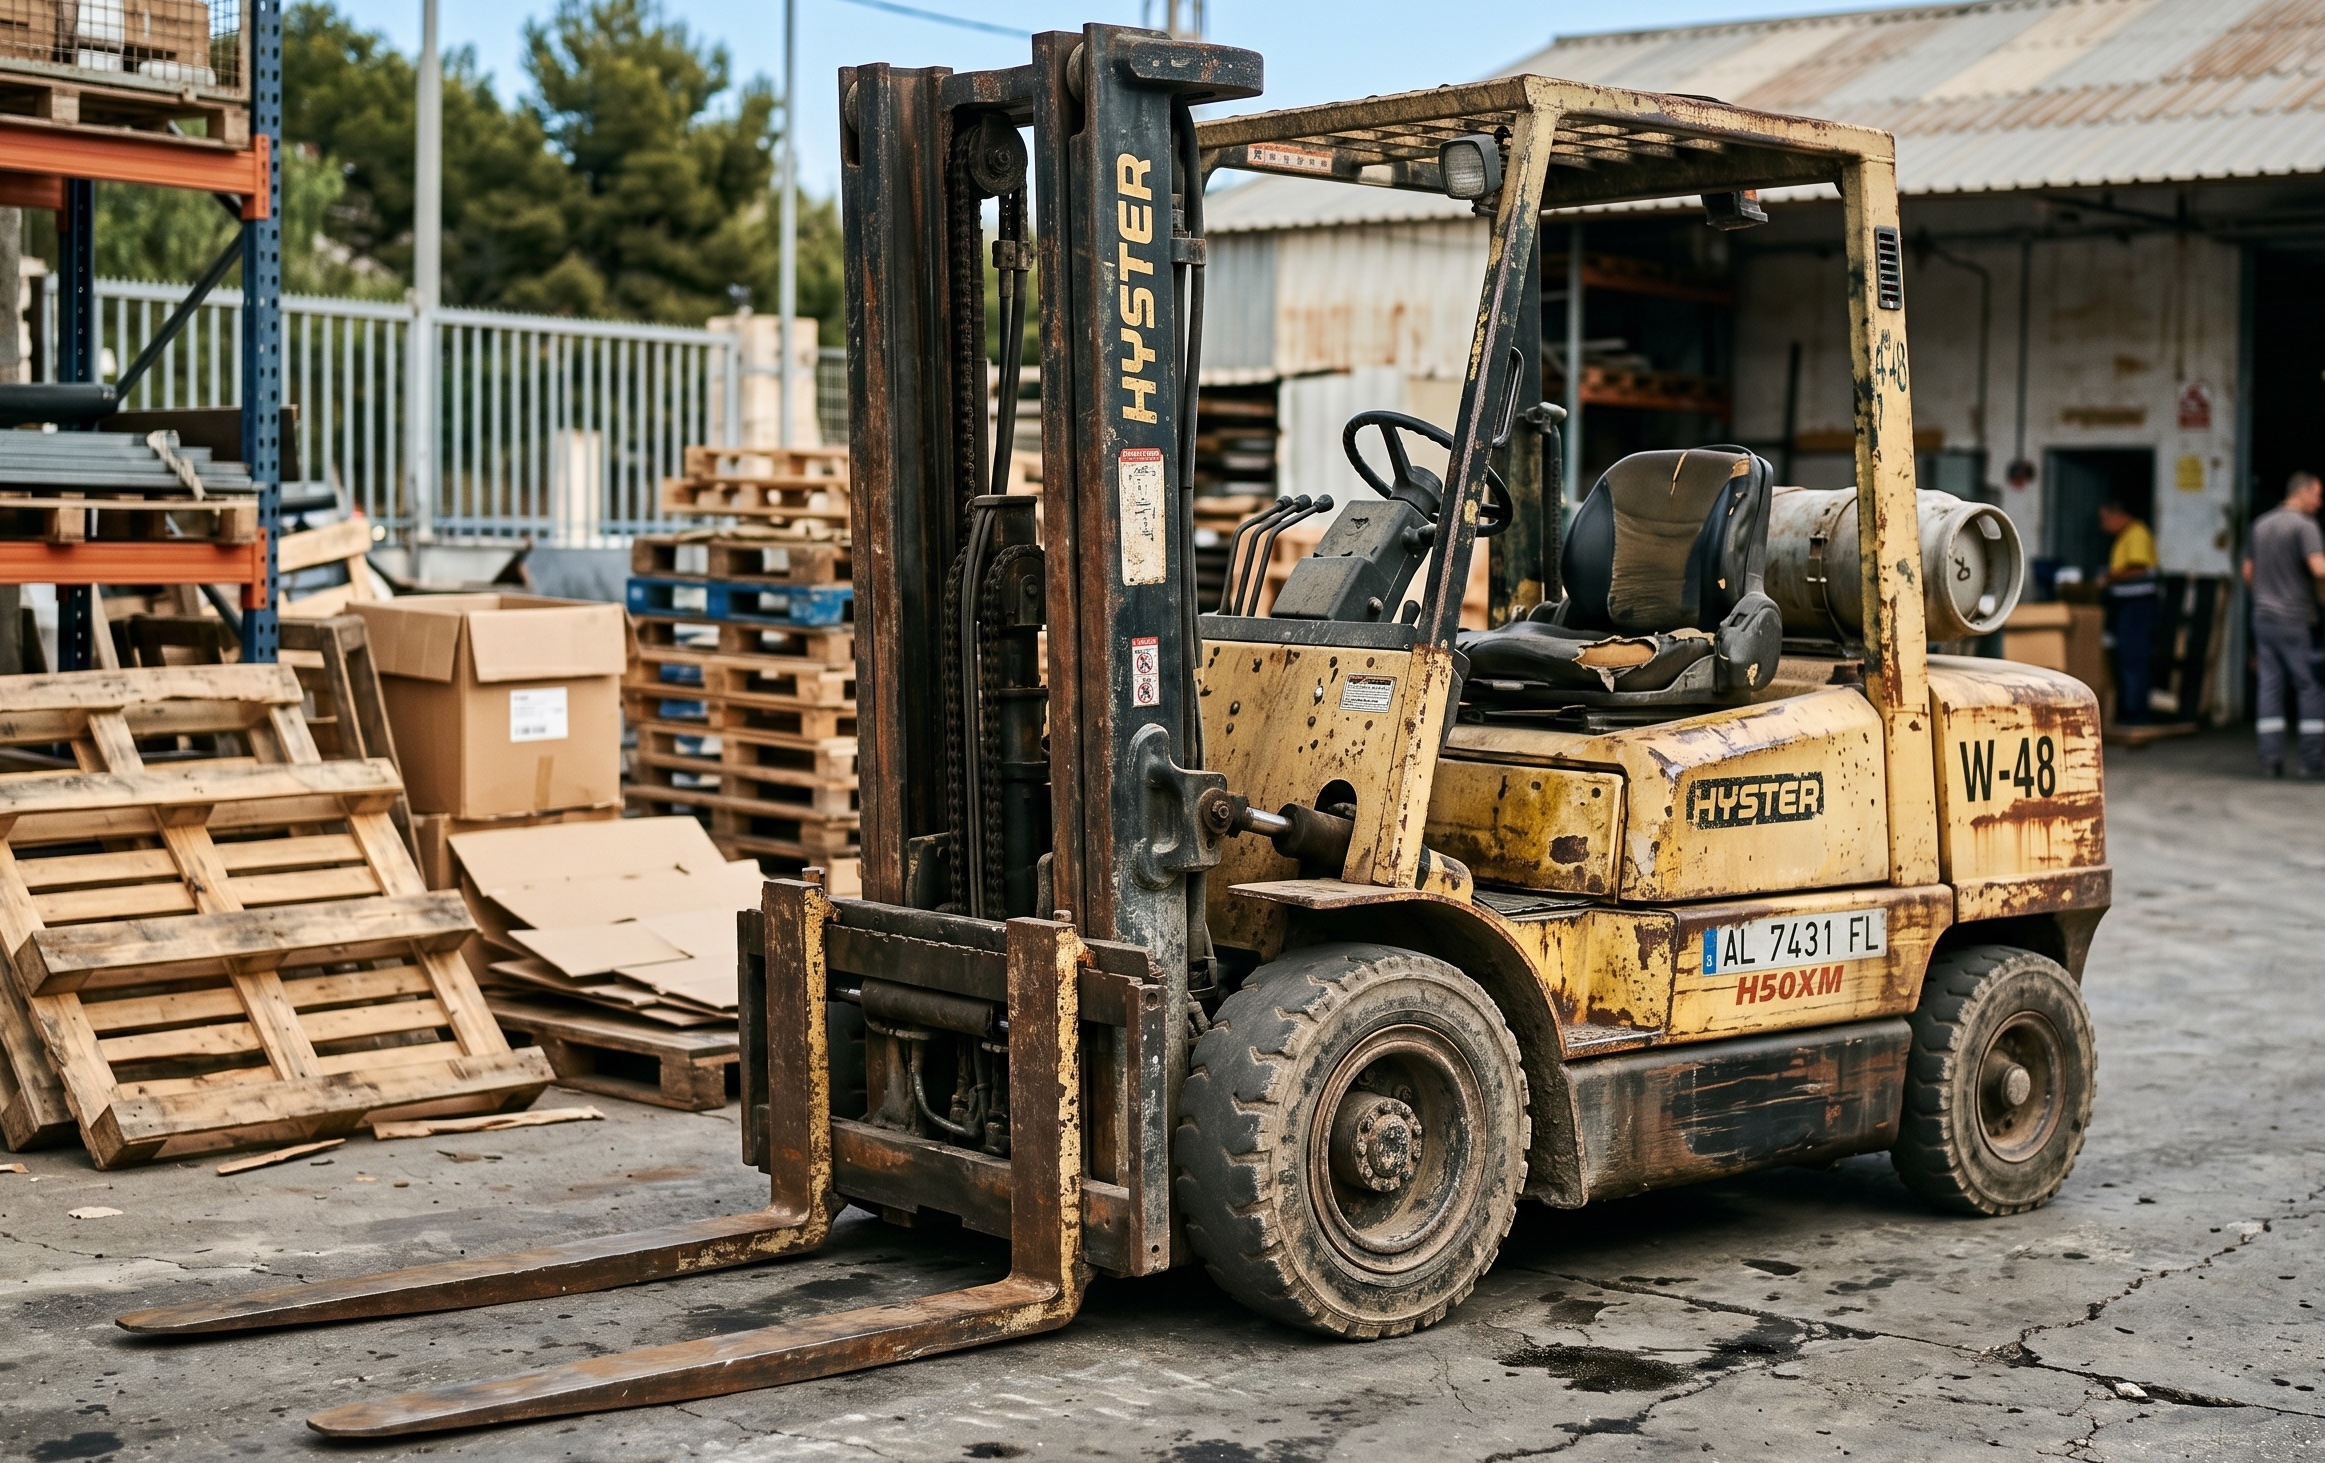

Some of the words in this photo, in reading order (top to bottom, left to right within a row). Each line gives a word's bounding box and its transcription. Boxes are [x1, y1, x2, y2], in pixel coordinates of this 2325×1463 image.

[1117, 152, 1158, 424] HYSTER
[1959, 735, 2056, 802] W-48
[1693, 779, 1820, 821] HYSTER
[1723, 928, 1755, 966] AL
[1770, 919, 1831, 962] 7431
[1850, 915, 1879, 952] FL
[1735, 965, 1845, 1006] H50XM
